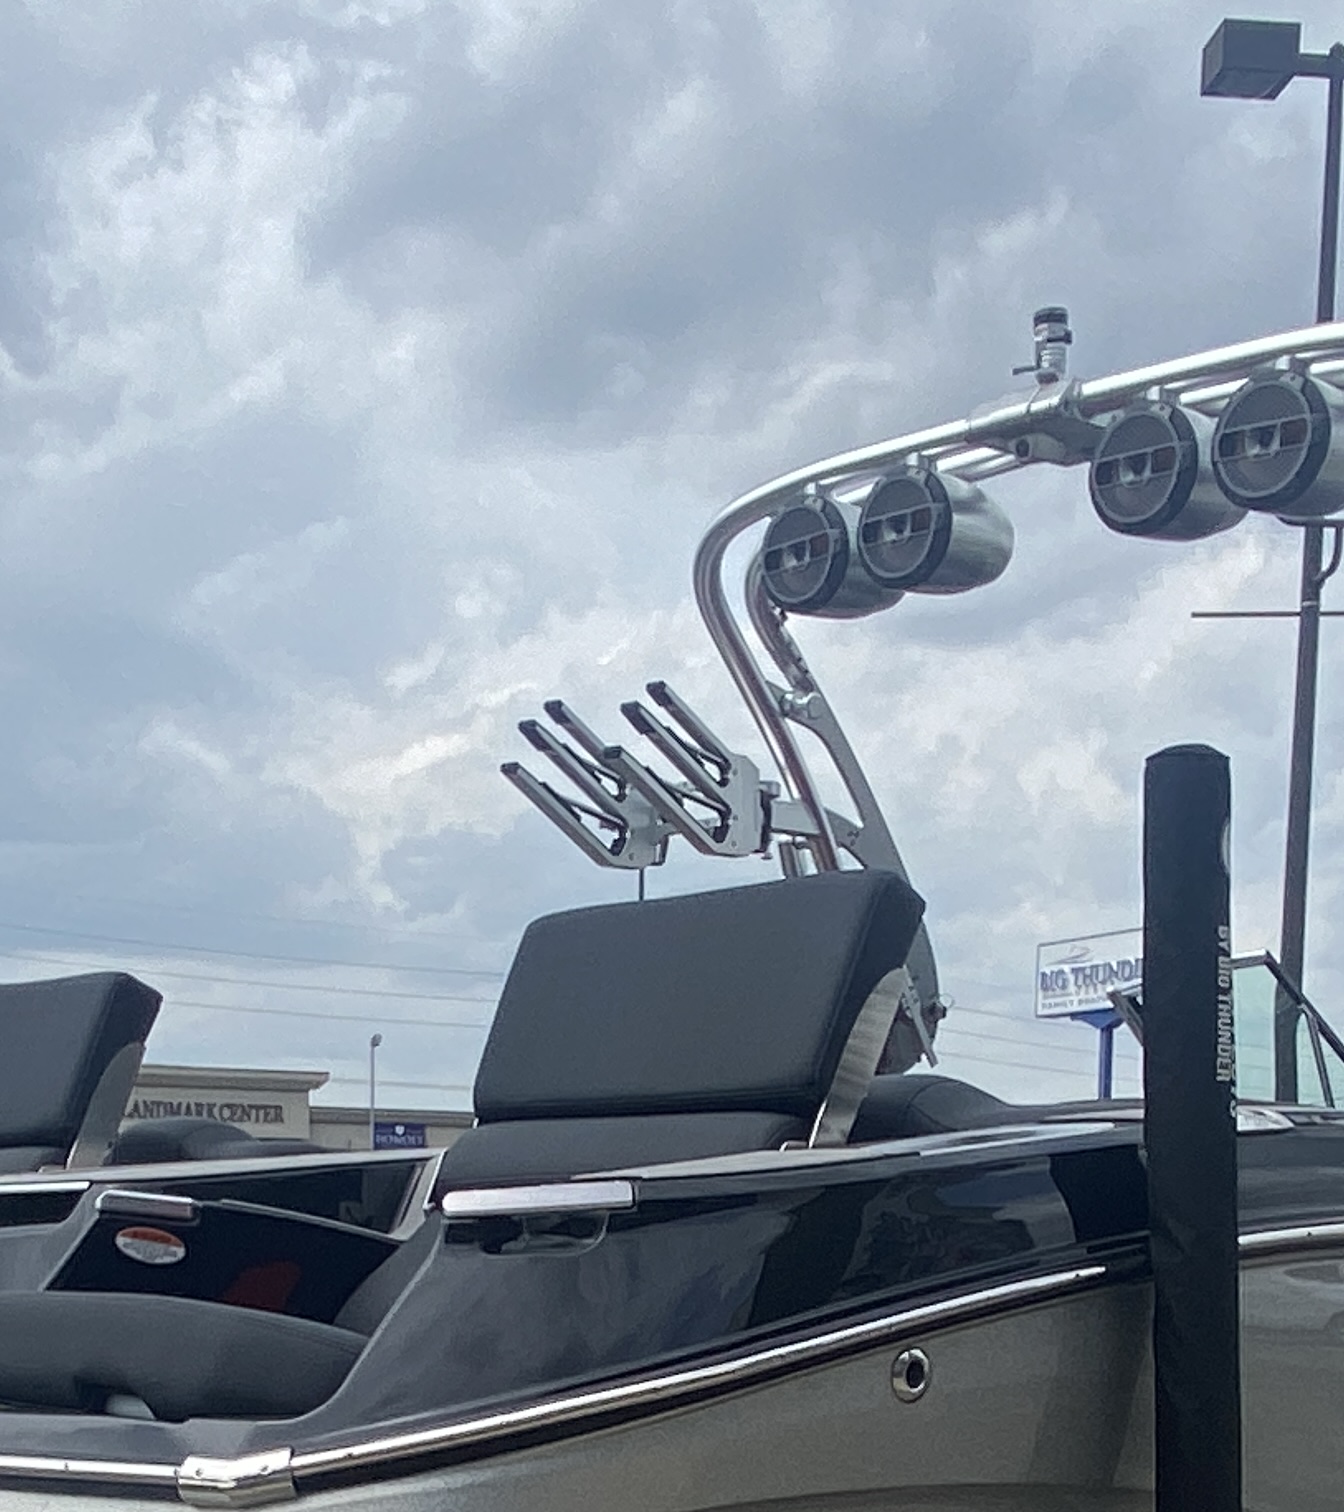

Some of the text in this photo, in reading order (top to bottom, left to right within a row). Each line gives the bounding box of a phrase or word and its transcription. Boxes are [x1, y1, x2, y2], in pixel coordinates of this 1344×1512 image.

[1215, 994, 1233, 1083] THUNDER
[124, 1100, 285, 1124] ANDMARK CENTER
